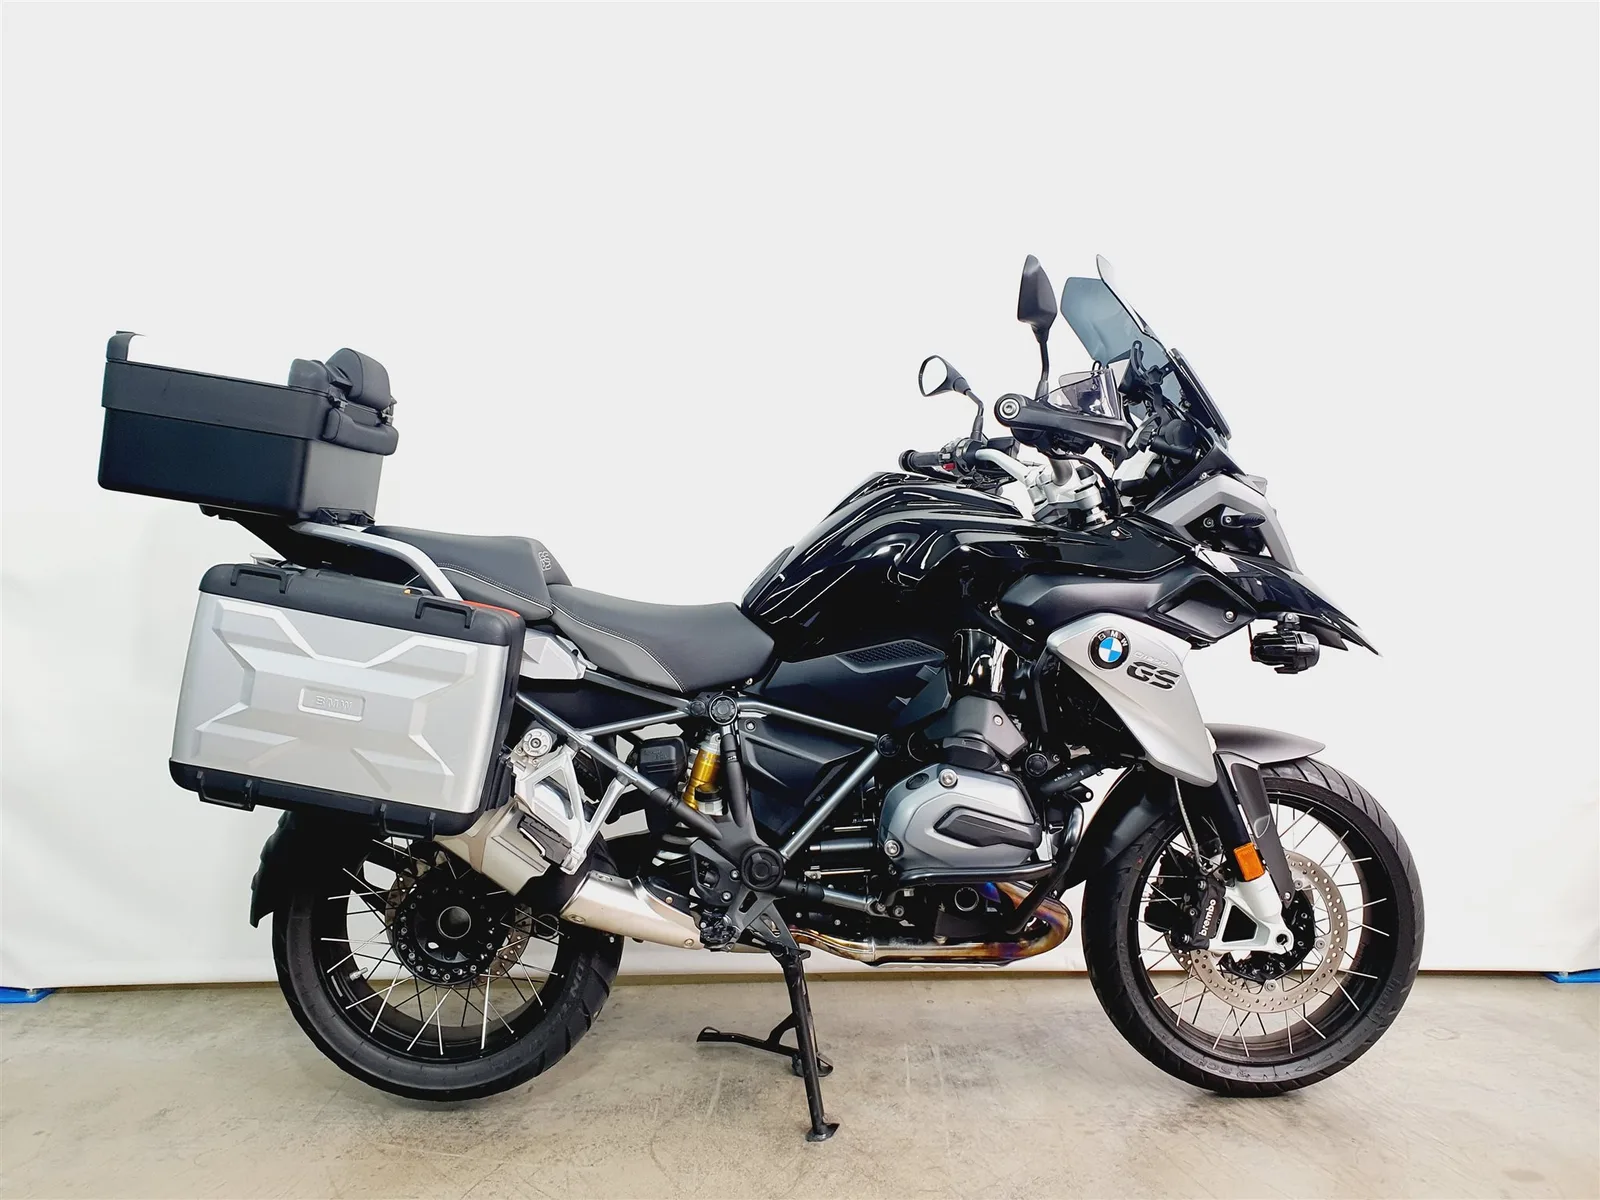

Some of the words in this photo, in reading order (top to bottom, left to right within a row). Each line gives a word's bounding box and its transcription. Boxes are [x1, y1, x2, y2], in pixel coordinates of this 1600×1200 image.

[1126, 661, 1181, 690] GS
[315, 695, 353, 709] BMW
[1199, 899, 1217, 936] brembo
